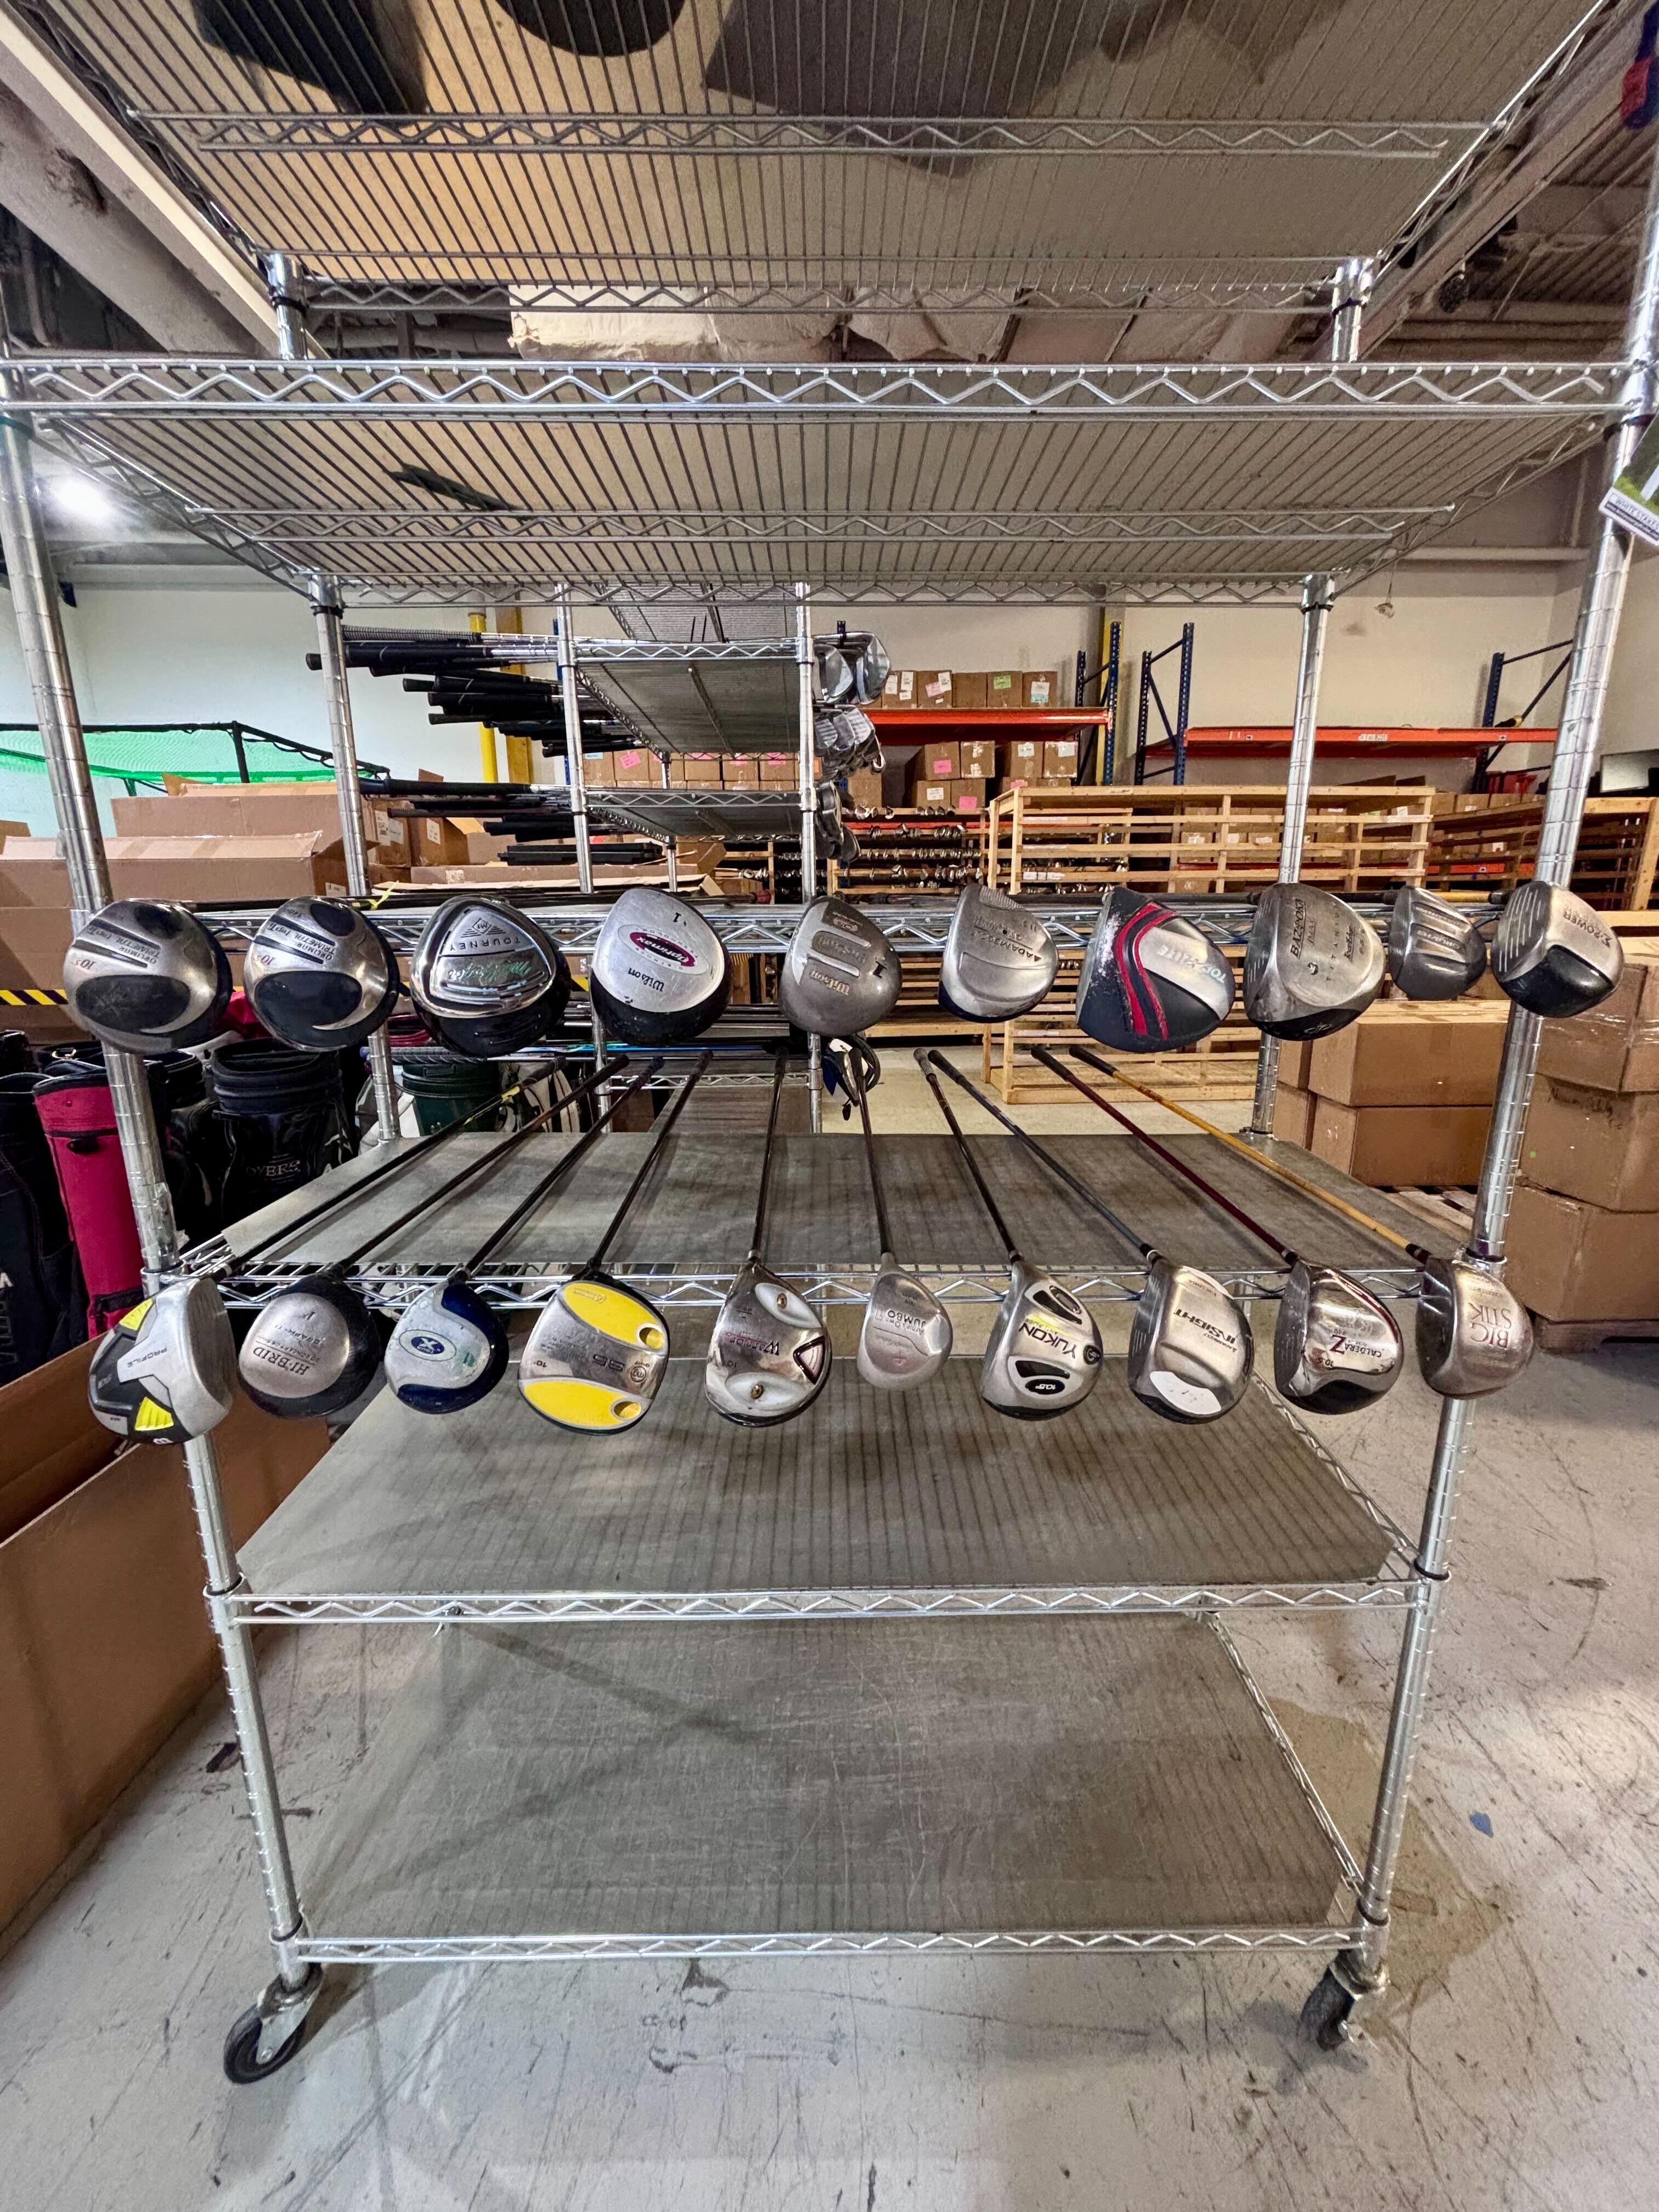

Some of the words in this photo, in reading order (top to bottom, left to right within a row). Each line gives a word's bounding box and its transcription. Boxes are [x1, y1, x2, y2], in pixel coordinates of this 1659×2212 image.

[1615, 496, 1636, 517] WHITE
[673, 913, 681, 923] 1
[116, 936, 160, 958] TRIMETAL
[294, 932, 335, 955] TRIMETAL
[297, 943, 332, 961] ORLIMAR
[450, 937, 520, 951] TOURNEY
[636, 936, 689, 962] Optimax
[119, 946, 156, 964] ORLIMAR
[634, 947, 683, 970] DISTANCE
[872, 961, 887, 978] 1
[1200, 967, 1226, 984] TOP
[628, 968, 664, 992] Wilson
[809, 970, 850, 995] Wilson
[884, 1318, 900, 1328] Own
[888, 1310, 926, 1328] JUMBO
[1468, 1302, 1511, 1329] STIK
[902, 1323, 924, 1335] Arnie's
[1173, 1309, 1235, 1344] INSIGHT
[1470, 1322, 1509, 1349] BIG
[729, 1338, 780, 1356] Warrior
[1019, 1323, 1076, 1359] YUKON
[127, 1347, 167, 1368] PROFILE
[1317, 1358, 1334, 1367] 10.5
[633, 1369, 645, 1379] mg
